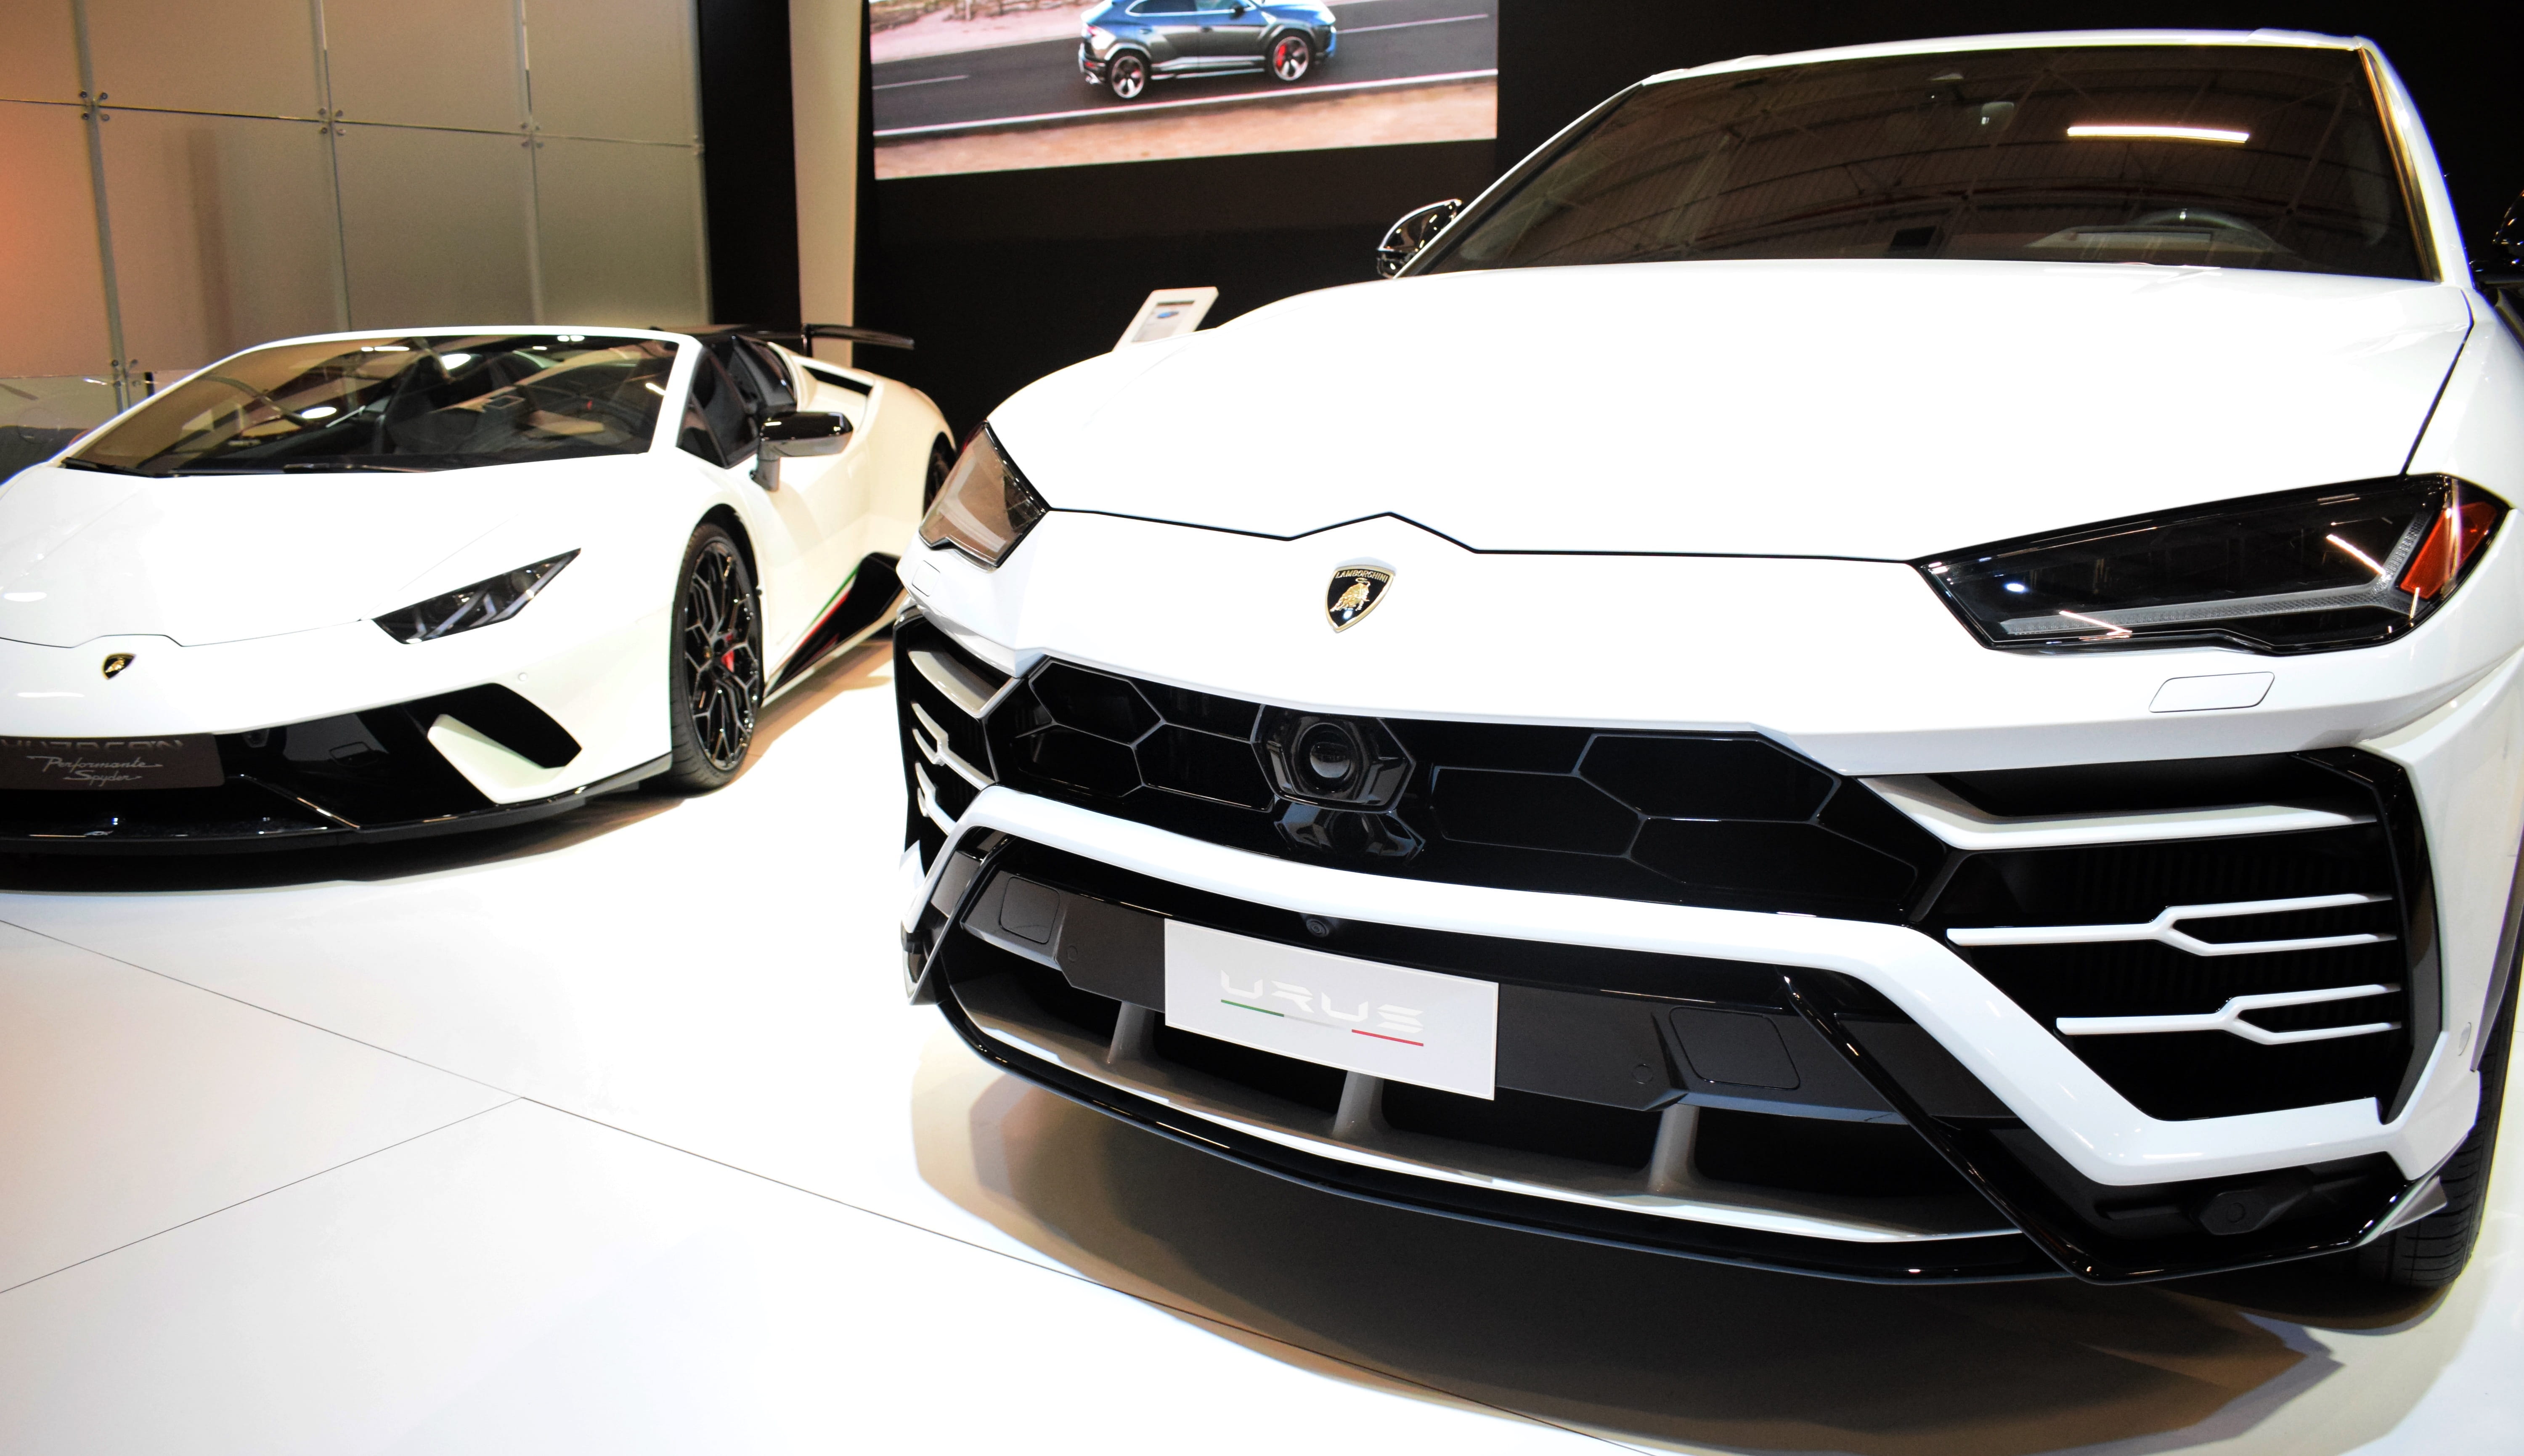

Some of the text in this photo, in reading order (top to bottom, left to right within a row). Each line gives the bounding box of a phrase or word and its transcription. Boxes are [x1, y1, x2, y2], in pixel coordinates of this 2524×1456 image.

[1335, 570, 1389, 583] LAMBORGHINI
[27, 756, 163, 772] Performante
[63, 770, 143, 787] Spyder
[1220, 969, 1424, 1034] URUS
